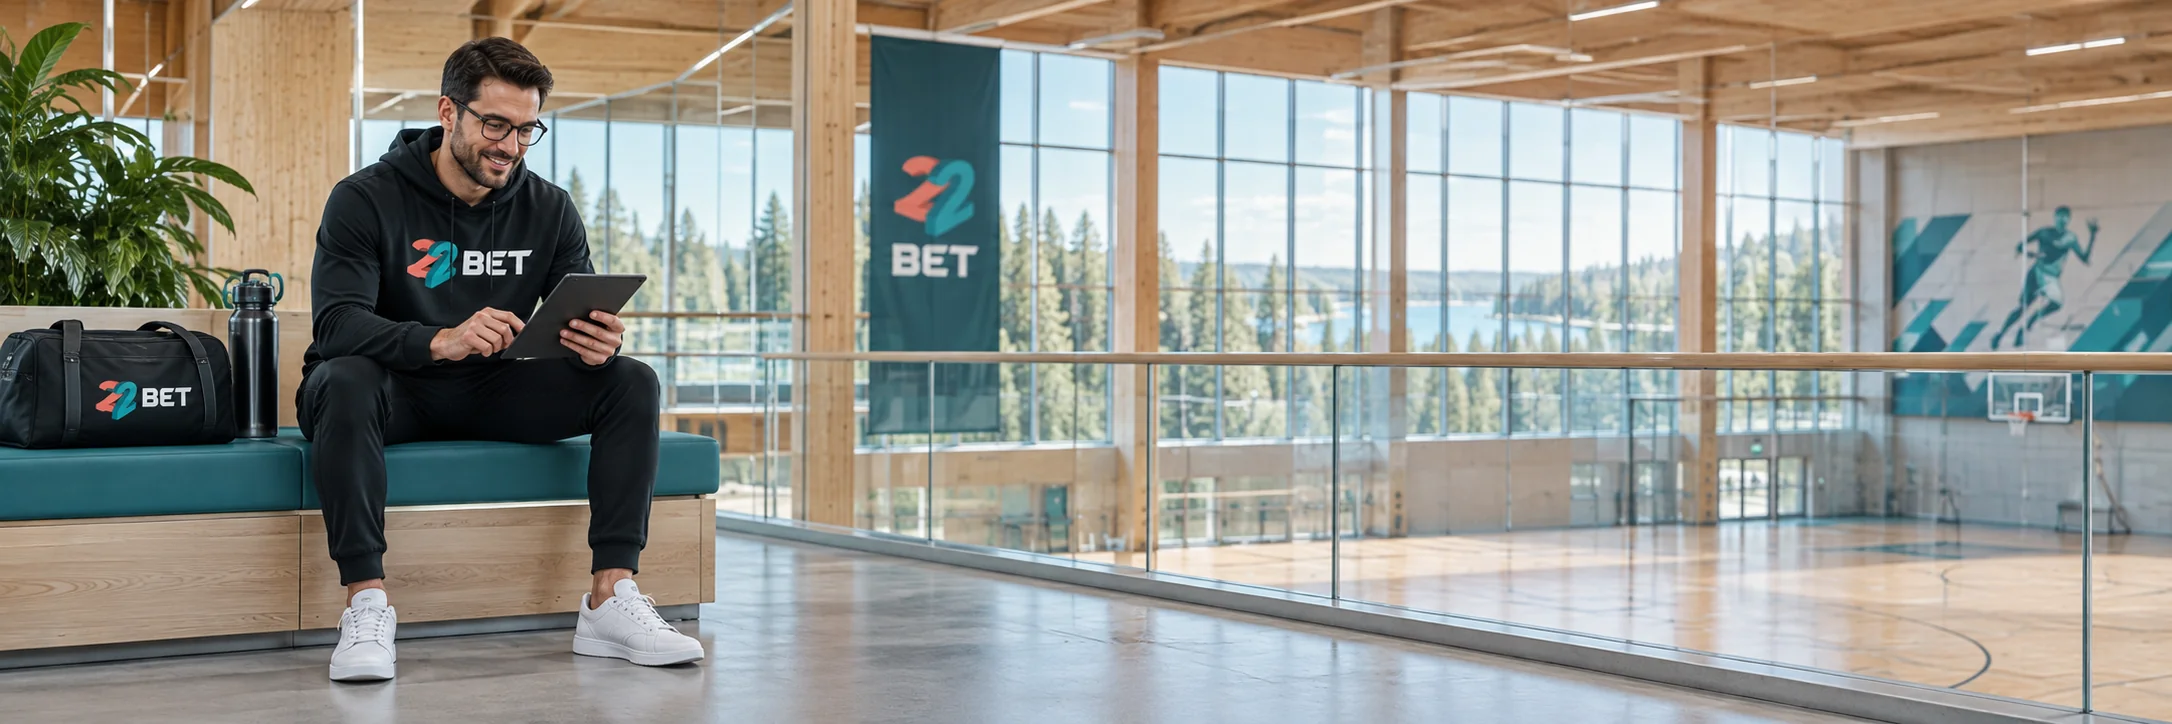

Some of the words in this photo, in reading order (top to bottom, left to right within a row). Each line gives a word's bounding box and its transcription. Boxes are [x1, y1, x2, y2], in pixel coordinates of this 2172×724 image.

[894, 155, 976, 237] 22
[462, 249, 533, 276] BET
[891, 242, 979, 278] BET
[141, 387, 192, 408] BET
